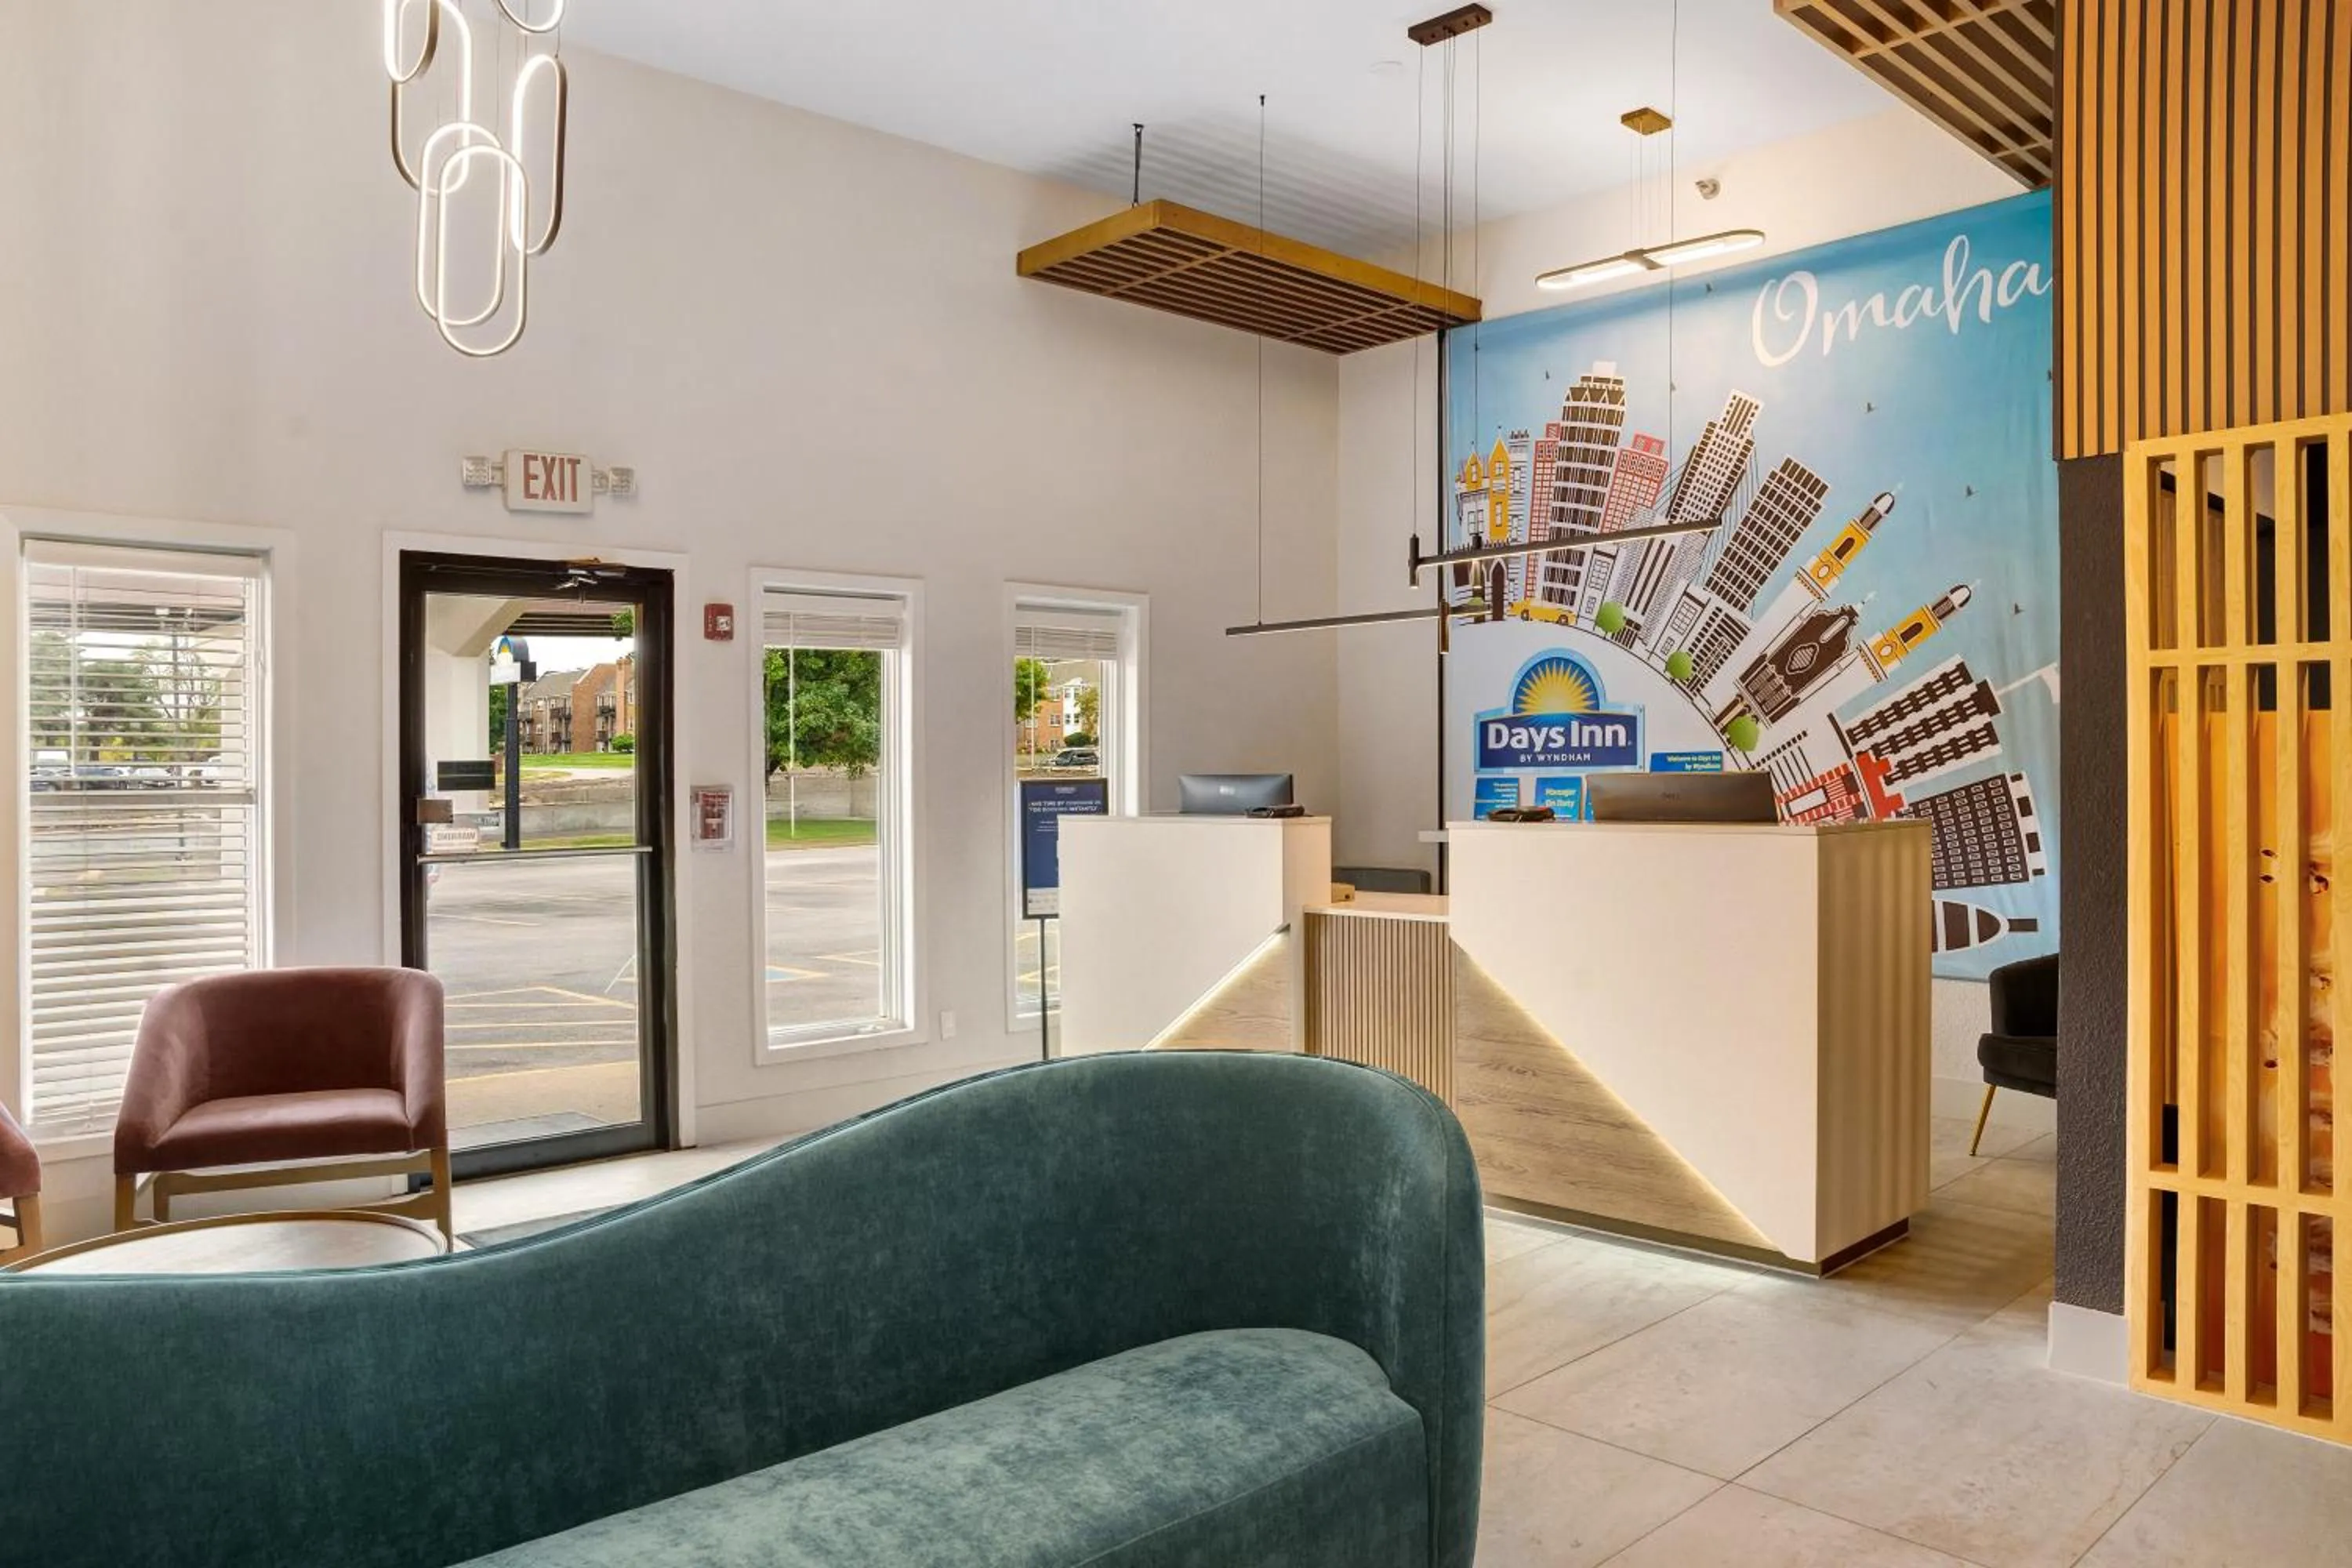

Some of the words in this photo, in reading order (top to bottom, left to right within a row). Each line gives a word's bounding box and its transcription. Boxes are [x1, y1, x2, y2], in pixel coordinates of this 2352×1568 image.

[1751, 234, 2053, 366] Omaha
[523, 454, 580, 503] EXIT
[1487, 722, 1565, 752] Days
[1570, 720, 1627, 747] Inn
[1519, 753, 1532, 763] BY
[1537, 753, 1591, 762] WYNDHAM
